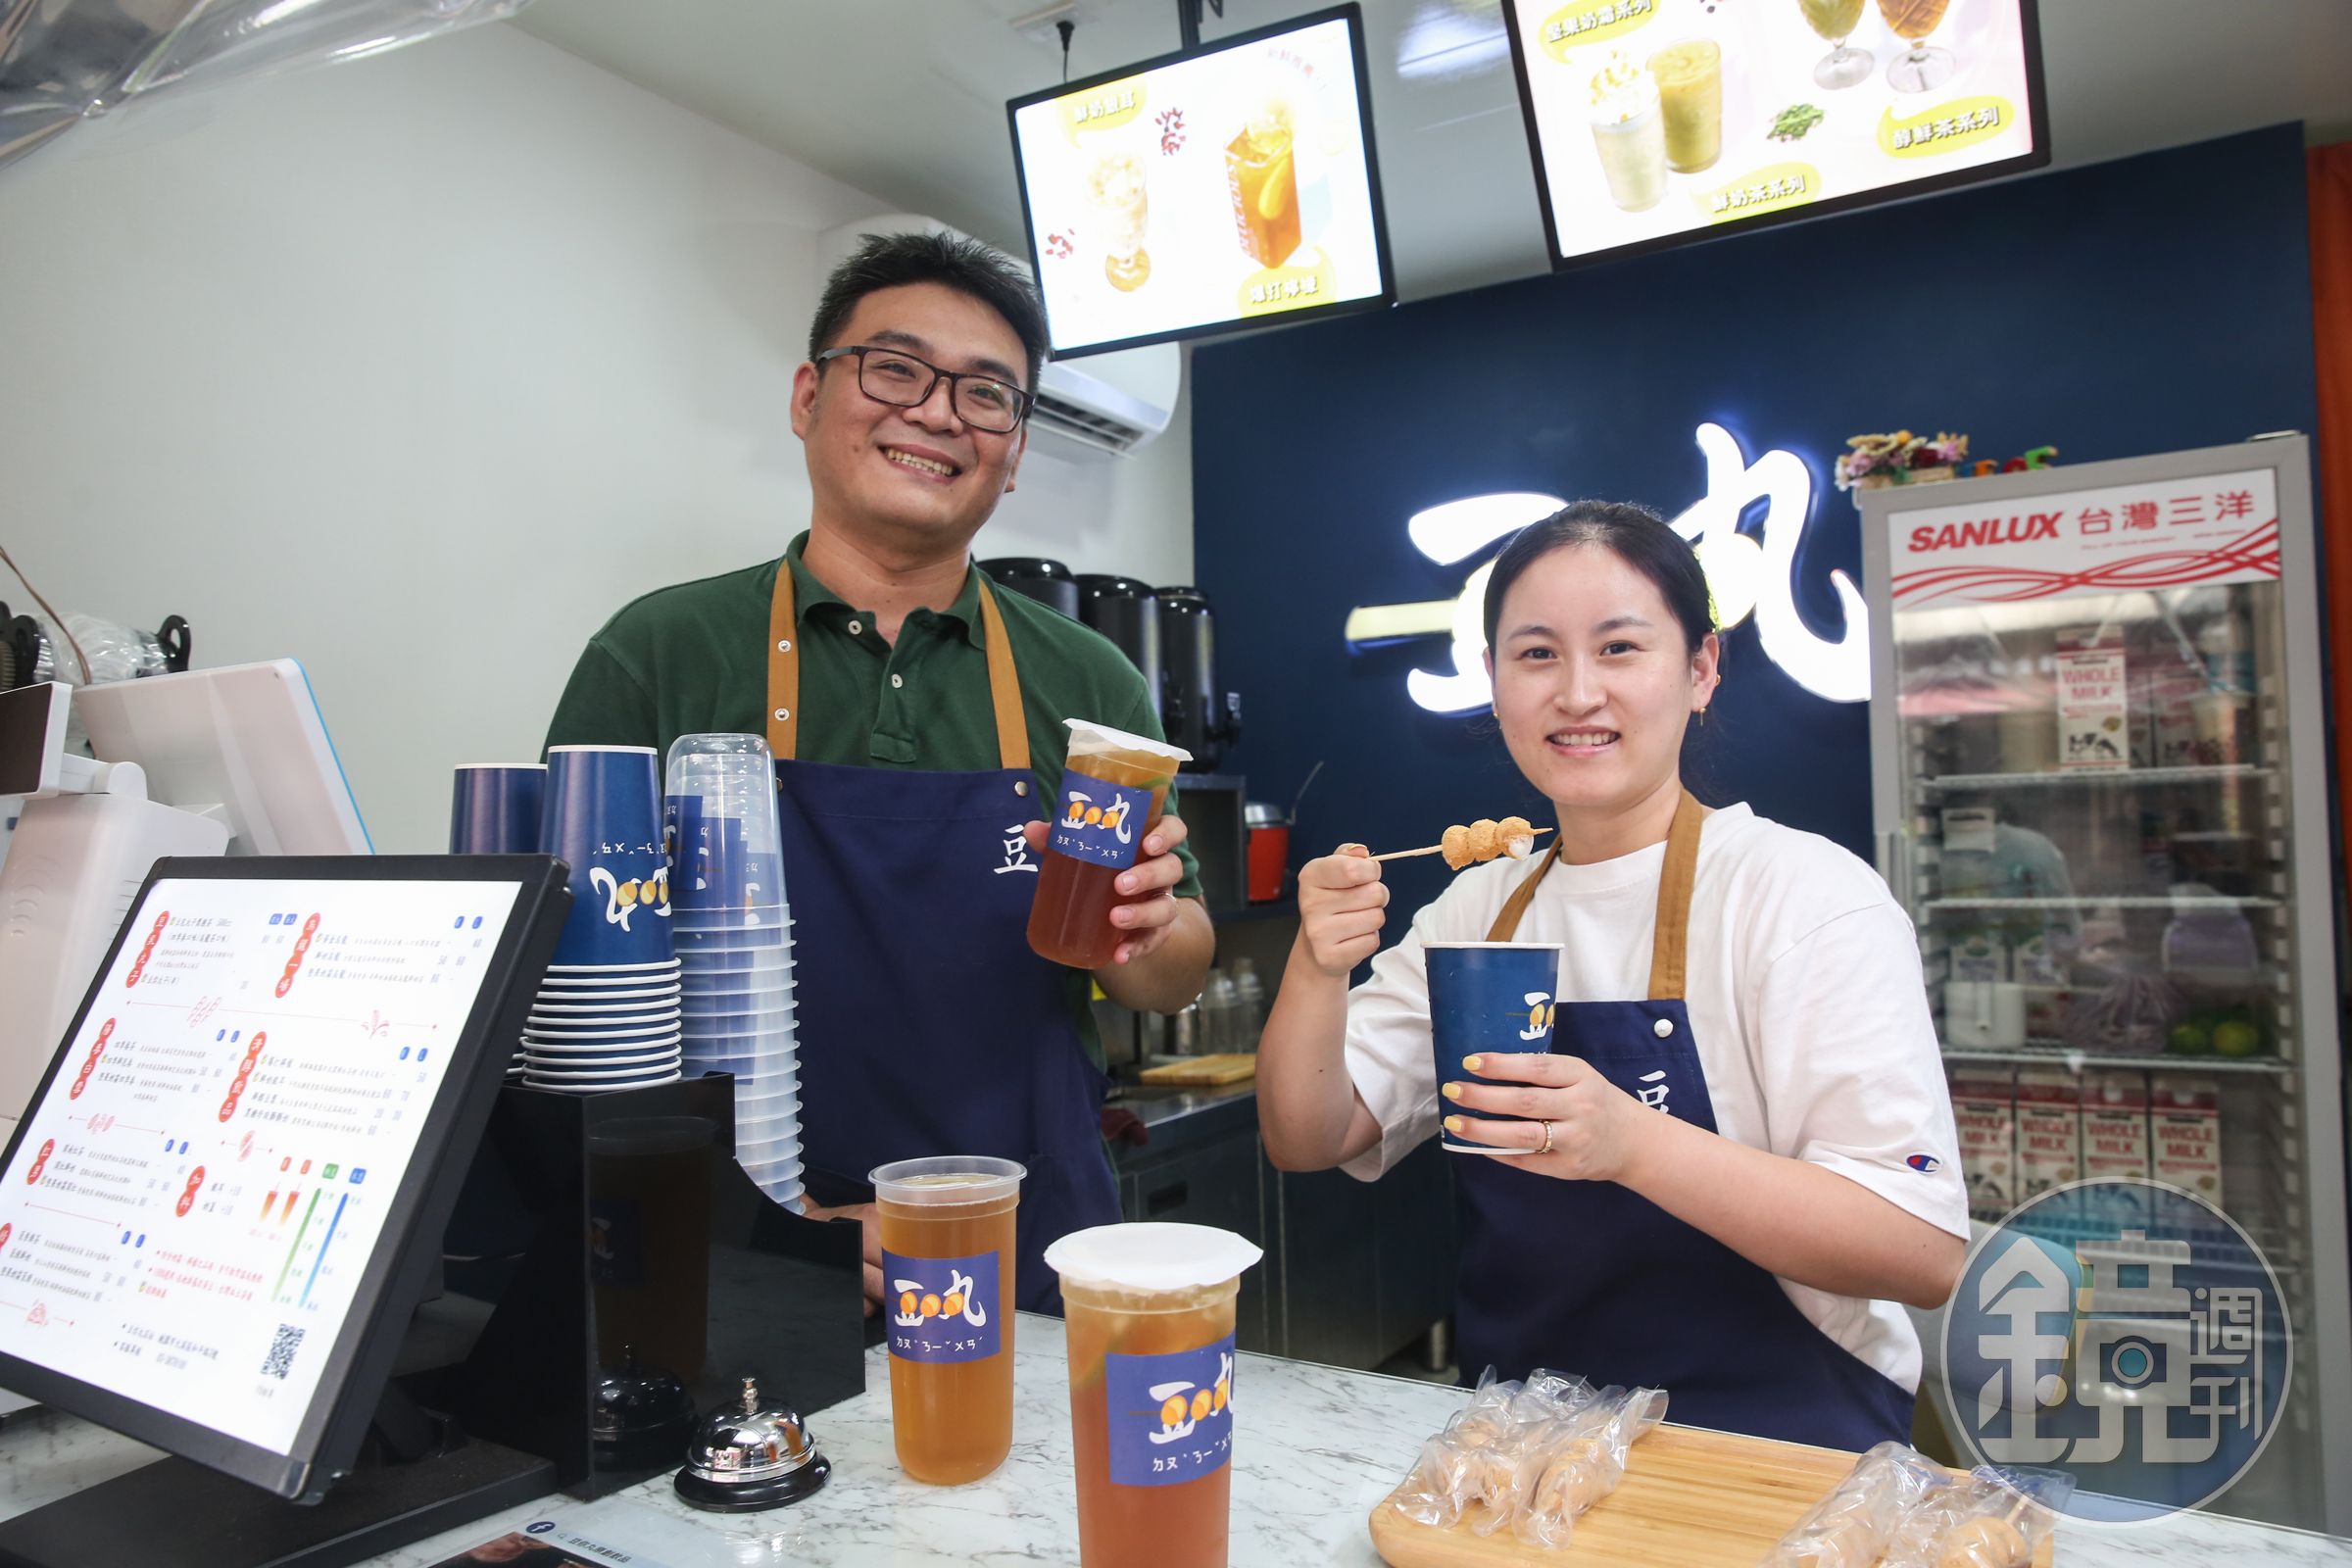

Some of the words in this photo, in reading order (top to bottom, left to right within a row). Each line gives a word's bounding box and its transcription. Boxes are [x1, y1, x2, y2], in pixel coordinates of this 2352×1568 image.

[1908, 512, 2063, 553] SANLUX
[2077, 490, 2255, 535] 台灣三洋
[993, 824, 1039, 874] 豆
